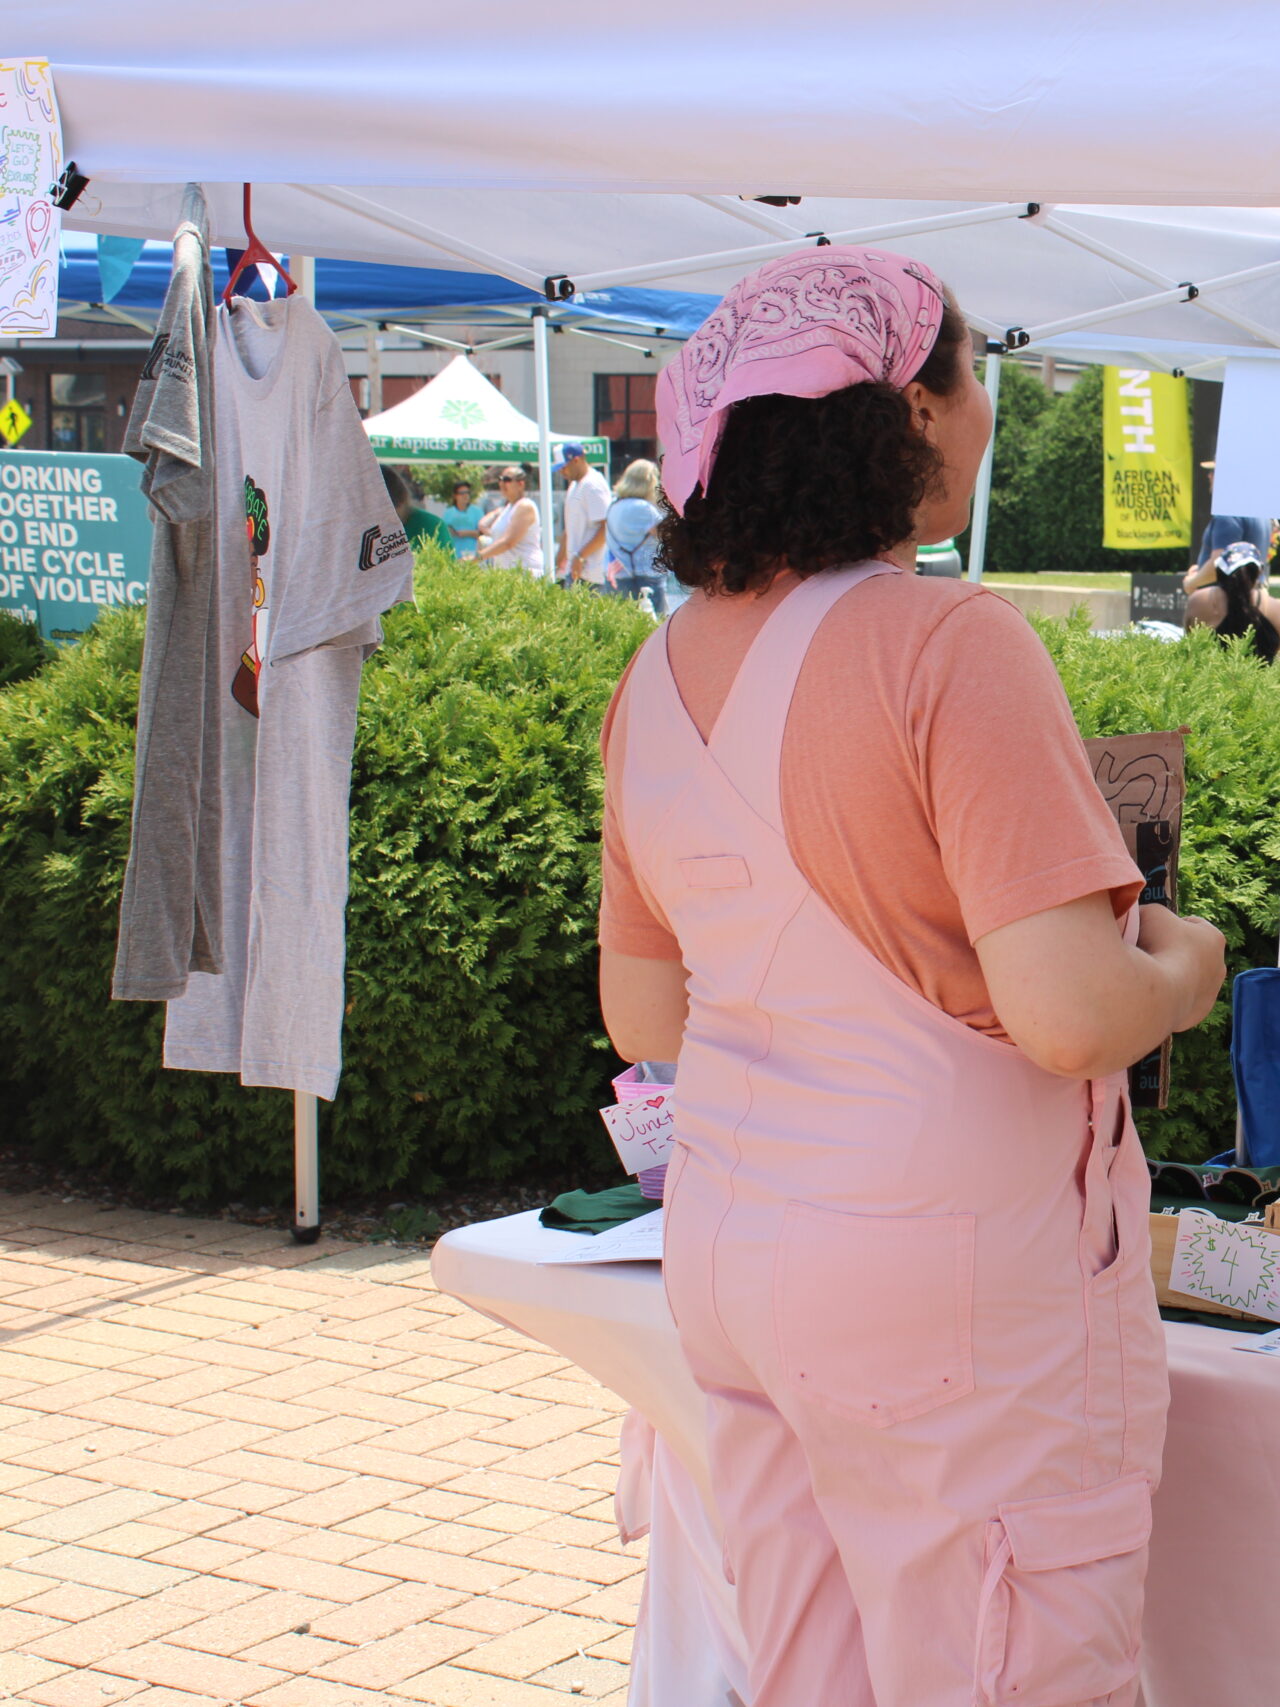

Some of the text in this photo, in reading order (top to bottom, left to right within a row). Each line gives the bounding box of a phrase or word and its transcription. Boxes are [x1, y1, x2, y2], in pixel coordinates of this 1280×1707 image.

[1119, 369, 1156, 454] NTH
[392, 436, 449, 453] Rapids
[453, 438, 496, 453] Parks
[501, 441, 513, 452] &
[0, 464, 102, 493] ORKING
[1114, 470, 1172, 483] AFRICAN
[1111, 483, 1181, 496] AMERICAN
[0, 492, 118, 522] OGETHER
[1115, 496, 1176, 509] MUSEUM
[1134, 509, 1172, 521] IOWA
[0, 519, 78, 547] O END
[1116, 530, 1182, 541] blackiowa.org
[0, 547, 126, 578] HE CYCLE
